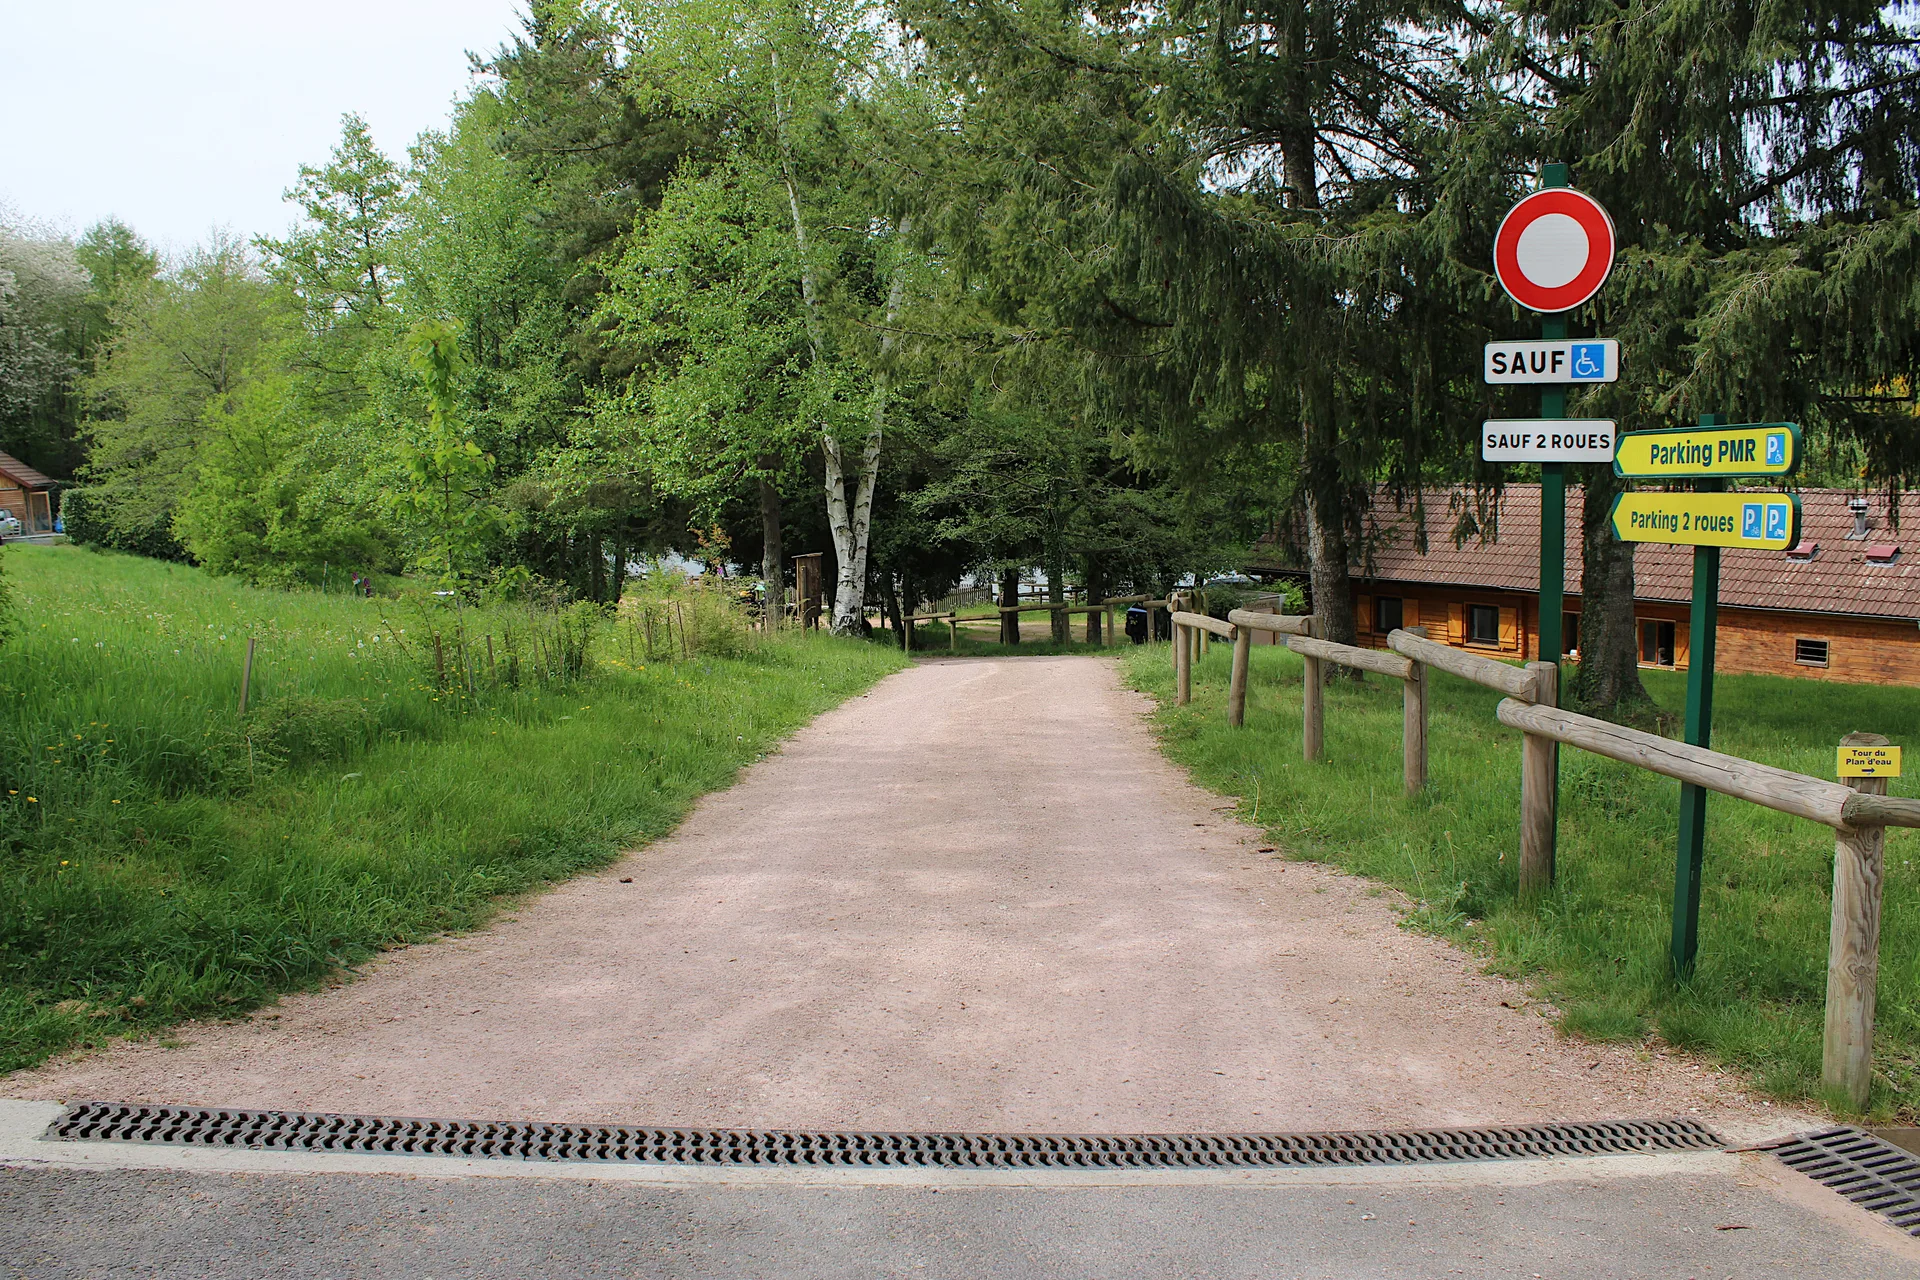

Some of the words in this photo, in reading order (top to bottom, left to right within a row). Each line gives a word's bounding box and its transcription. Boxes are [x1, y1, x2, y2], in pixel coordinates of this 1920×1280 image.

[1491, 351, 1565, 374] SAUF
[1487, 434, 1531, 449] SAUF
[1536, 434, 1547, 449] 2
[1551, 434, 1610, 449] ROUES
[1650, 440, 1712, 467] Parking
[1718, 438, 1756, 462] PMR
[1631, 510, 1678, 533] Parking
[1682, 513, 1690, 531] 2
[1694, 514, 1734, 532] roues
